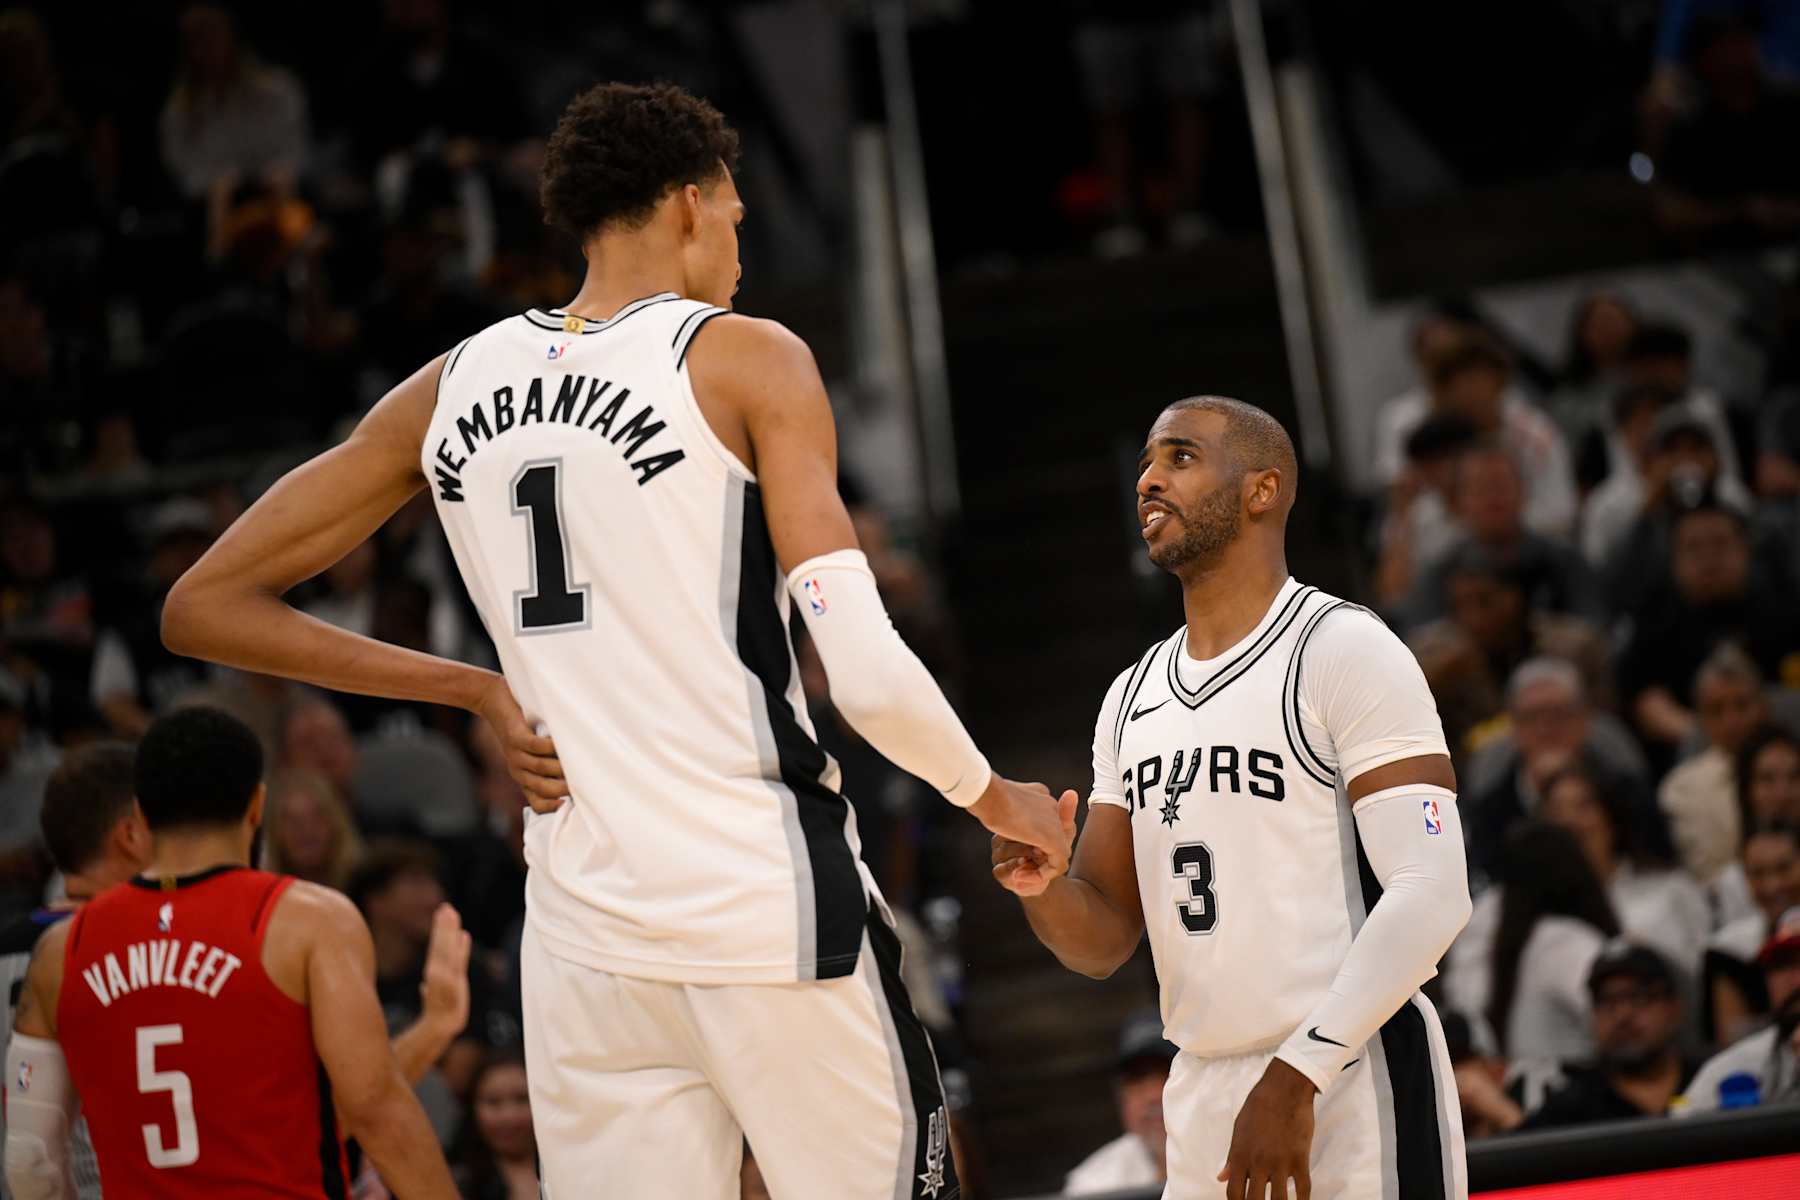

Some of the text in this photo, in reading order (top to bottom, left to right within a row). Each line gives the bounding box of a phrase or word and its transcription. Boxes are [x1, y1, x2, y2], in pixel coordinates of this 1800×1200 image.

[434, 374, 686, 503] WEMBANYAMA
[509, 456, 592, 637] 1
[1170, 841, 1220, 937] 3
[82, 939, 242, 1008] VANVLEET
[135, 1023, 200, 1170] 5
